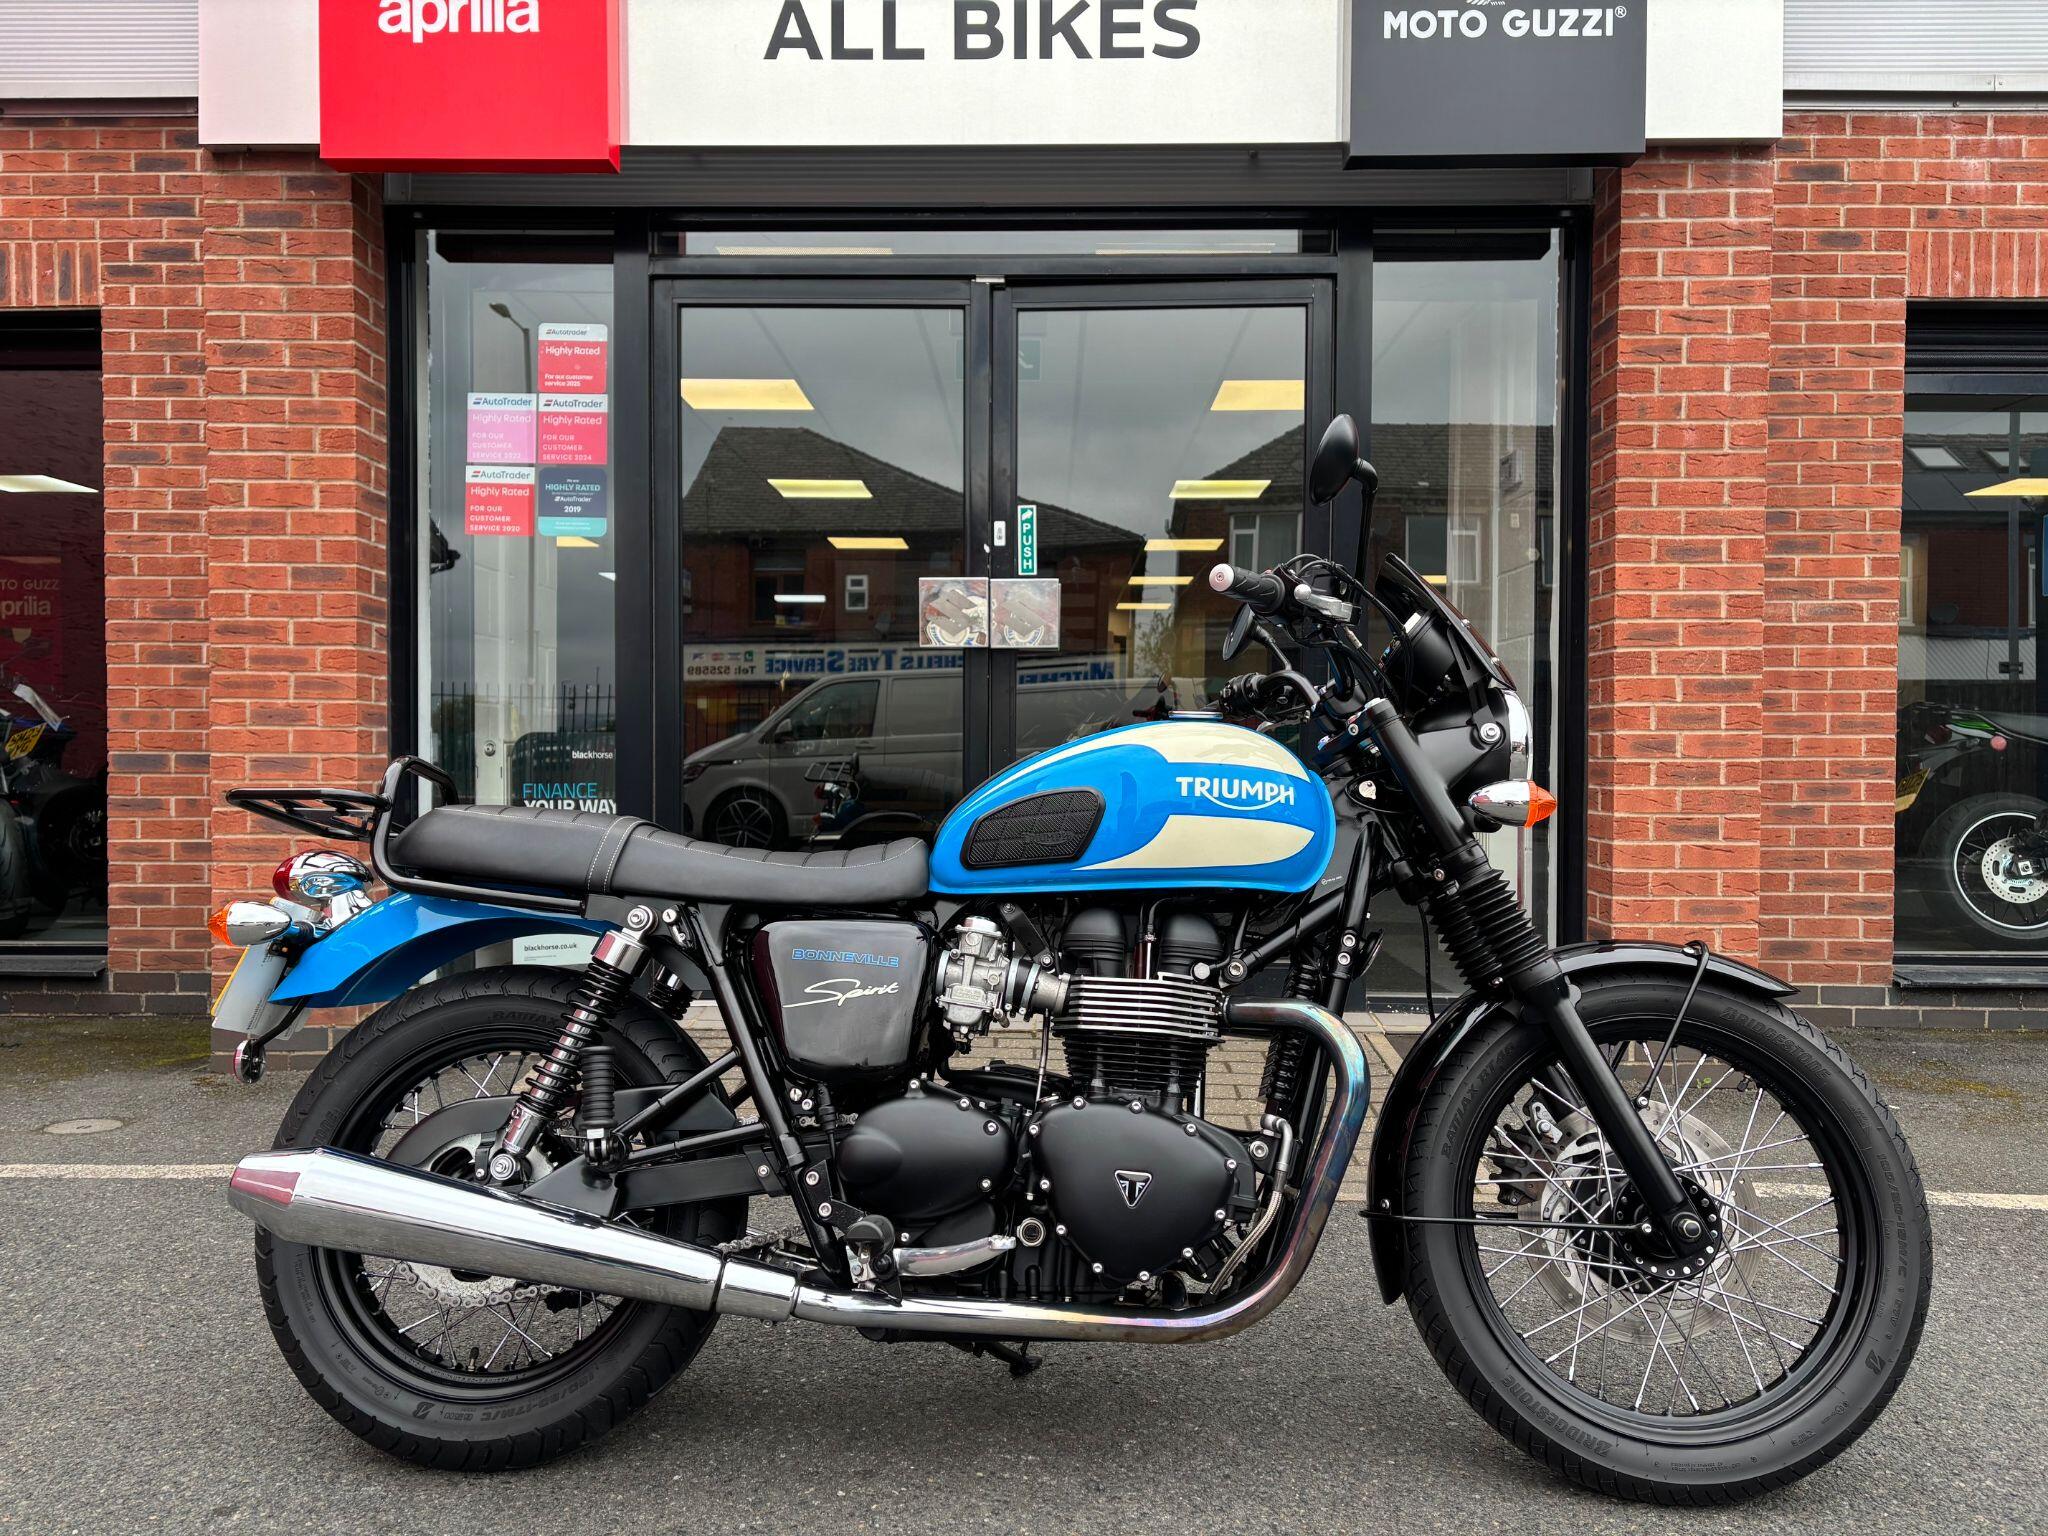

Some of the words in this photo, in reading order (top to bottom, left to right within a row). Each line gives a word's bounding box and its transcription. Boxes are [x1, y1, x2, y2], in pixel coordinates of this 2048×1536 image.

[378, 0, 540, 43] aprilia
[1383, 9, 1488, 39] MOTO
[764, 0, 925, 60] ALL
[954, 0, 1201, 60] BIKES
[545, 346, 573, 357] Highly
[574, 346, 600, 356] Rated
[482, 397, 532, 407] AutoTrader
[552, 399, 603, 408] AutoTrader
[472, 414, 502, 425] Highly
[503, 414, 532, 423] Rated
[543, 416, 573, 426] Highly
[574, 416, 602, 425] Rated
[480, 470, 531, 480] AutoTrader
[470, 487, 500, 497] Highly
[501, 487, 530, 496] Rated
[545, 484, 575, 492] HIGHLY
[576, 484, 601, 492] RATED
[1022, 523, 1033, 569] PUSH
[0, 595, 52, 620] prilia
[572, 750, 614, 760] blackhorse
[523, 783, 598, 799] FINANCE
[1176, 776, 1295, 811] TRIUMPH
[579, 799, 617, 815] WAY
[524, 942, 578, 952] blackhorse.co.uk
[792, 948, 900, 968] BONNEVILLE
[782, 978, 900, 1008] Spirit
[1720, 1006, 1832, 1079] BRIDGESTONE
[1501, 1374, 1614, 1458] BRIDGESTONE
